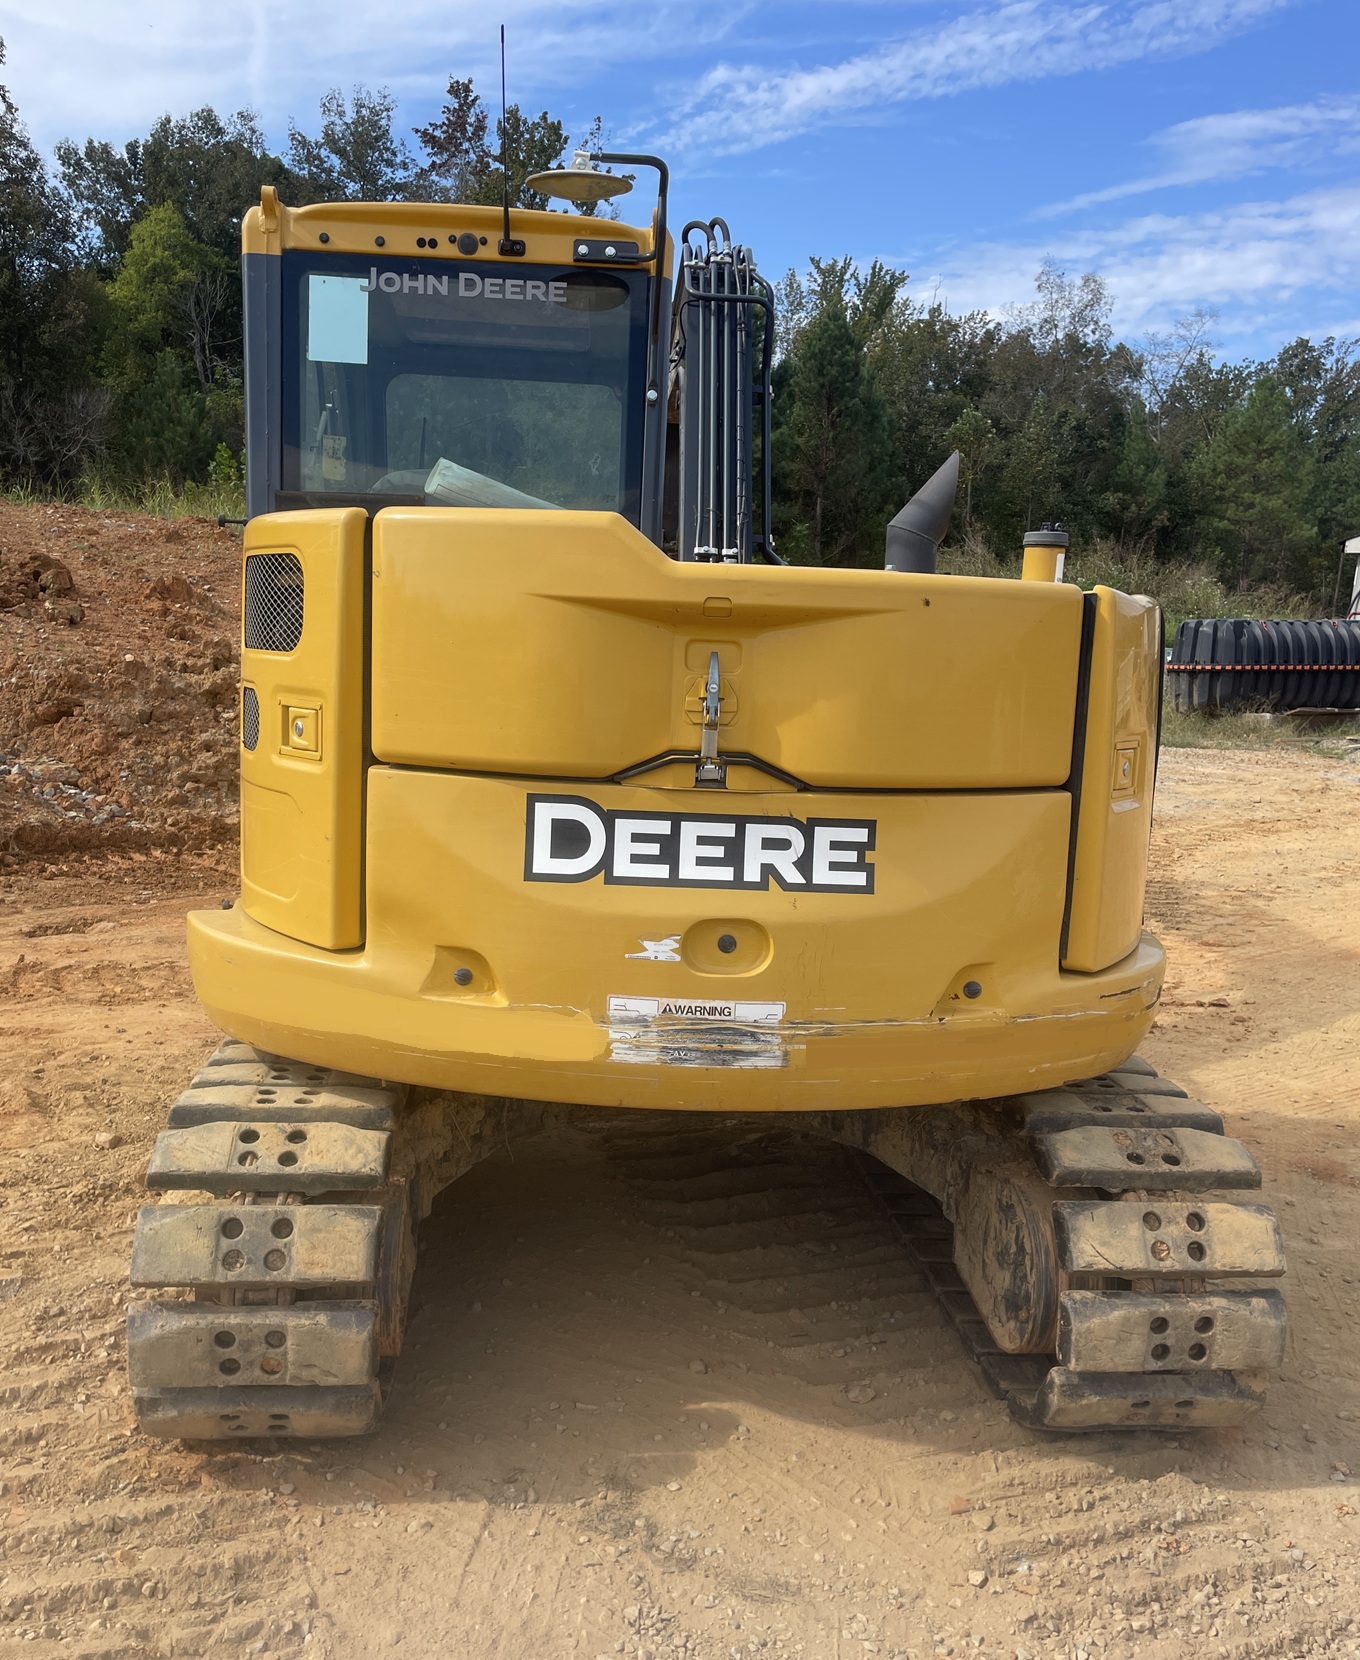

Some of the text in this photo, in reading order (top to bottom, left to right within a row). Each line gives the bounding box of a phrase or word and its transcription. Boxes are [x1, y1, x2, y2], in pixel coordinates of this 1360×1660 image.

[360, 267, 567, 302] JOHN DEERE
[532, 802, 869, 885] DEERE
[674, 1004, 732, 1017] WARNING
